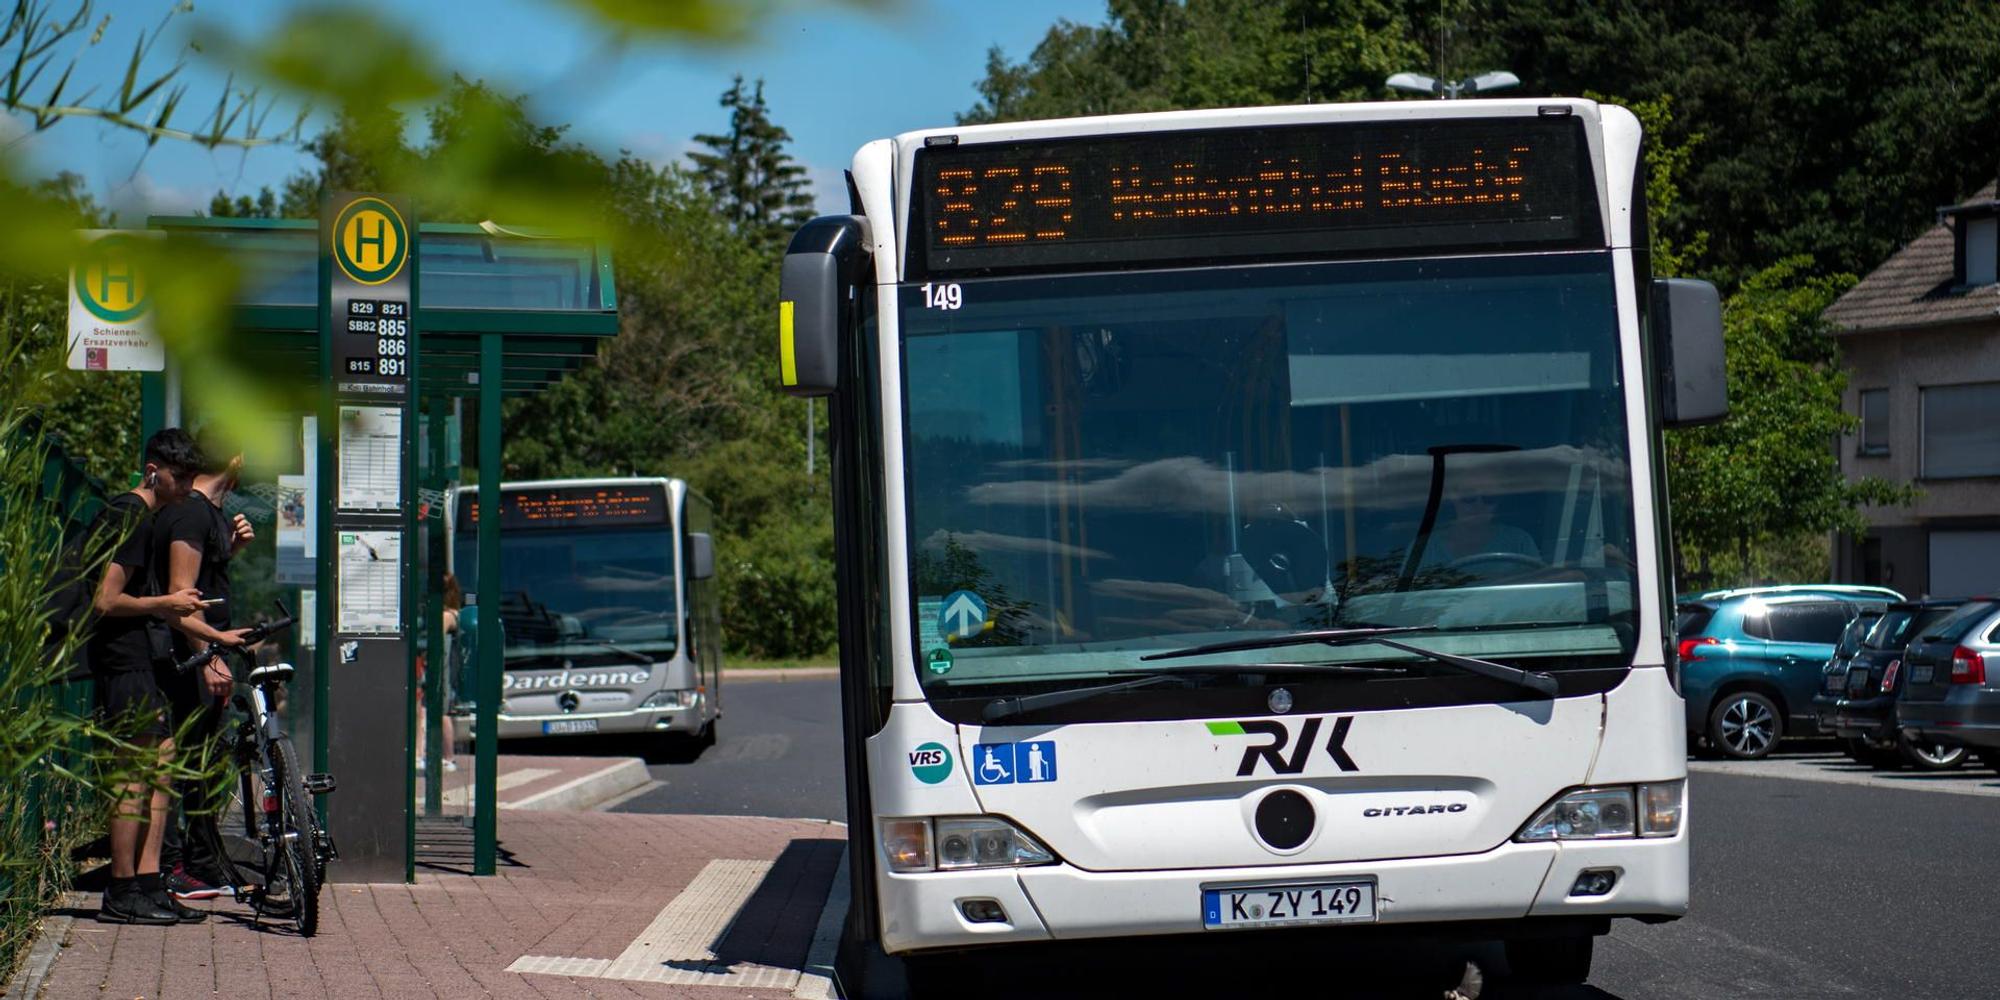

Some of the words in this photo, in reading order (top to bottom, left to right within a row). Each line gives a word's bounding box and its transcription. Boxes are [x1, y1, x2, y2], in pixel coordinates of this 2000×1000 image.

[937, 166, 1072, 244] 829
[1111, 155, 1365, 219] Hellenthal
[356, 217, 385, 264] H
[101, 256, 135, 303] H
[921, 283, 963, 310] 149
[352, 302, 374, 314] 829
[382, 304, 403, 315] 821
[93, 327, 140, 336] Schienen-
[348, 320, 376, 332] SB82
[378, 319, 406, 336] 885
[83, 338, 149, 348] Ersatzverkehr
[378, 339, 406, 356] 886
[350, 360, 371, 371] 815
[379, 358, 406, 375] 891
[909, 751, 942, 766] VRS
[1363, 803, 1468, 817] CITARO
[1231, 893, 1249, 920] K
[1268, 890, 1303, 918] ZY
[1311, 888, 1361, 916] 149
